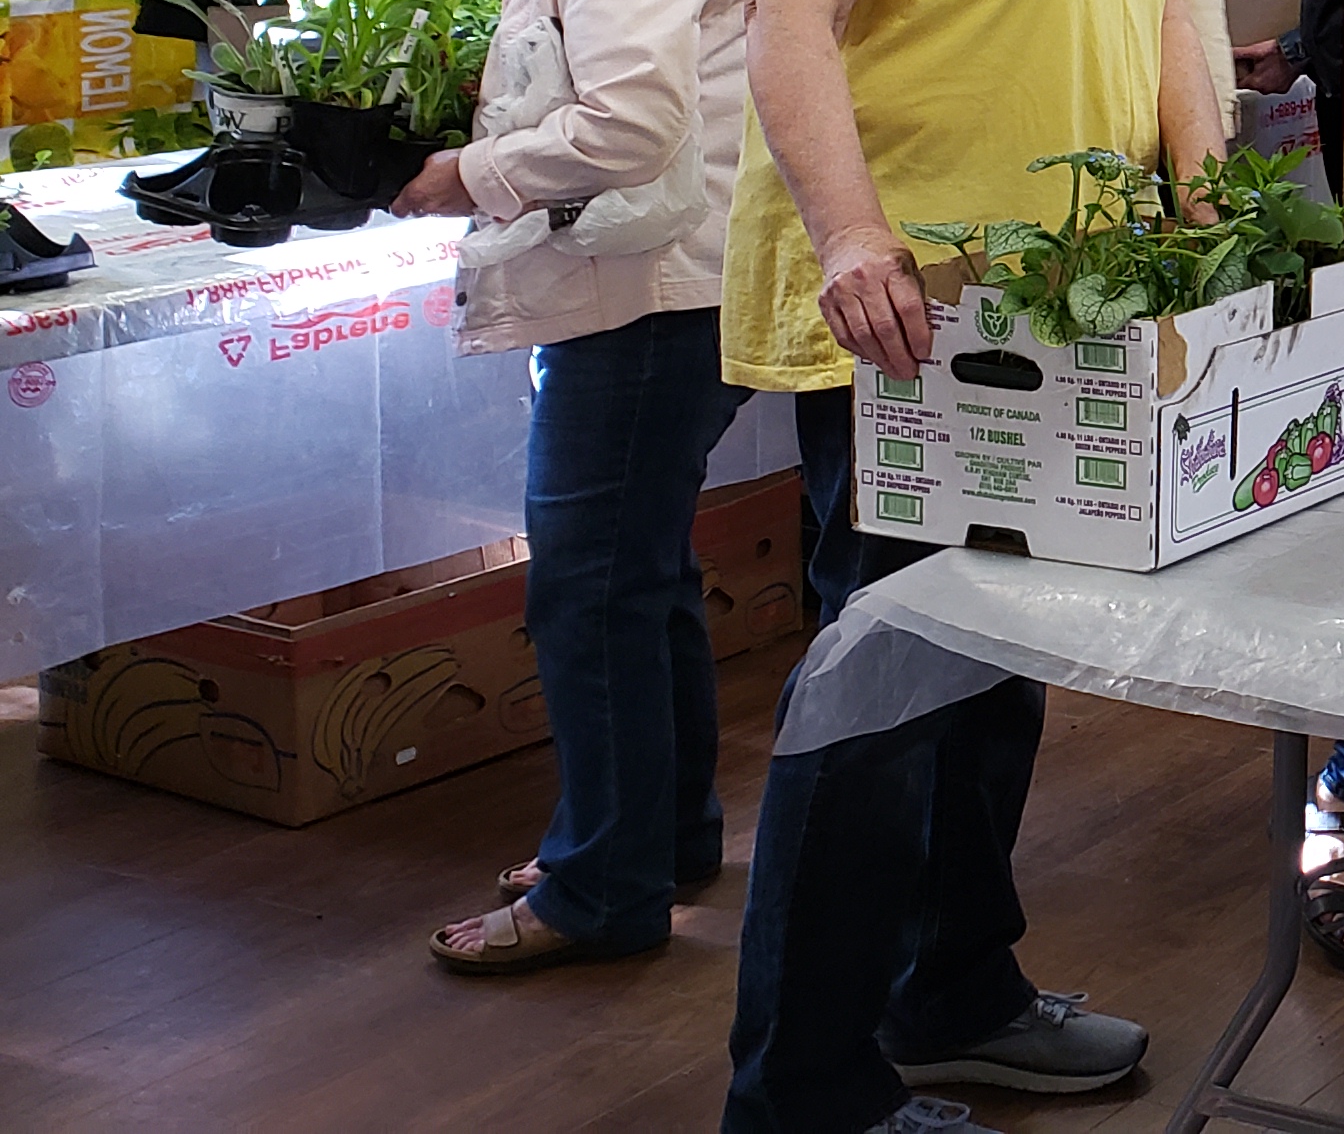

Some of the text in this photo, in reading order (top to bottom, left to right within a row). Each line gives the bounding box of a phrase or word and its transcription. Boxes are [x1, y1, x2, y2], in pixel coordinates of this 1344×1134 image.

[956, 402, 1042, 423] PRODUCT OF CANADA
[970, 426, 1026, 446] 1/2 BUSHEL
[1027, 459, 1043, 469] PAR
